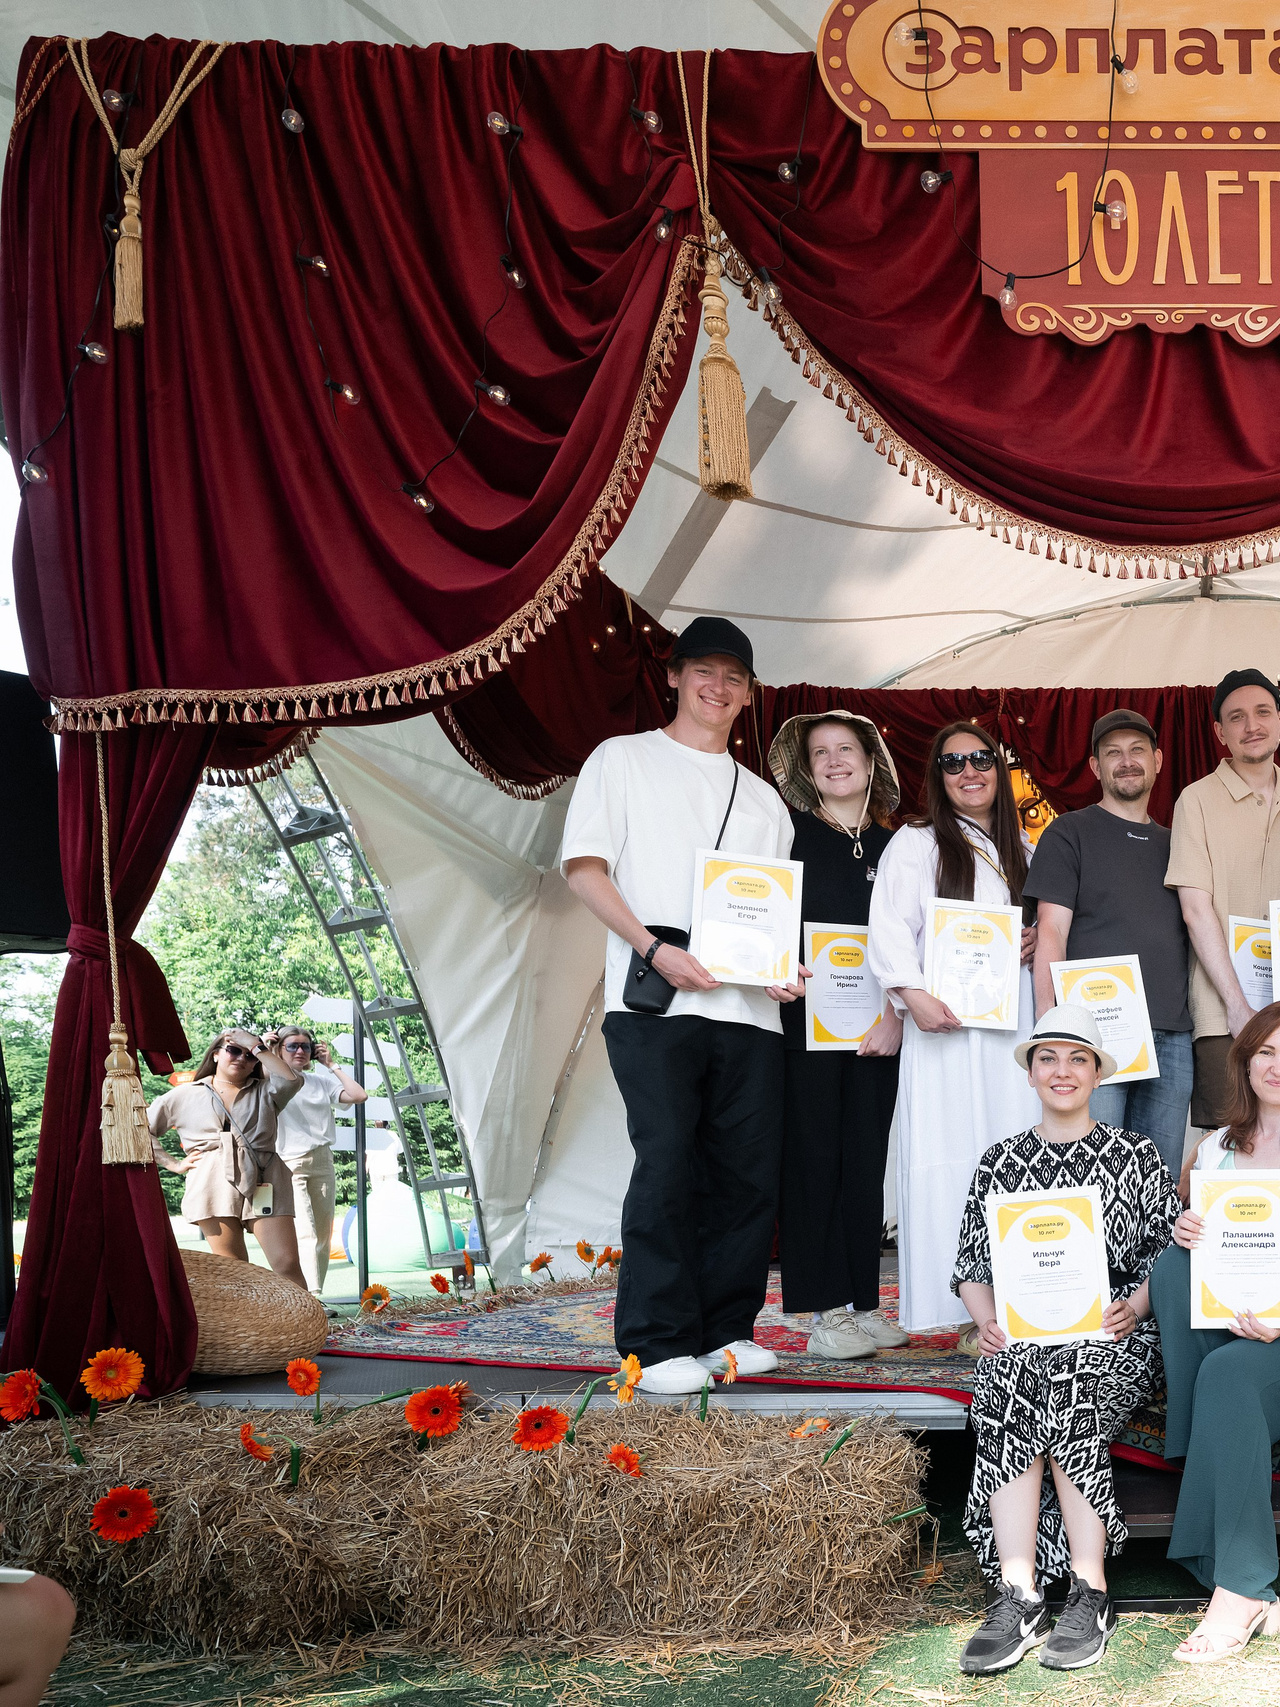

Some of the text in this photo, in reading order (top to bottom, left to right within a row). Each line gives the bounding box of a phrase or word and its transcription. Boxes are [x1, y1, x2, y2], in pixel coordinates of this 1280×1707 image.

[1056, 169, 1280, 286] 10 ЛЕТ
[727, 902, 768, 913] Землянов
[737, 912, 757, 920] Егор
[1253, 964, 1273, 972] Коцер
[1032, 1250, 1065, 1258] Ильчук
